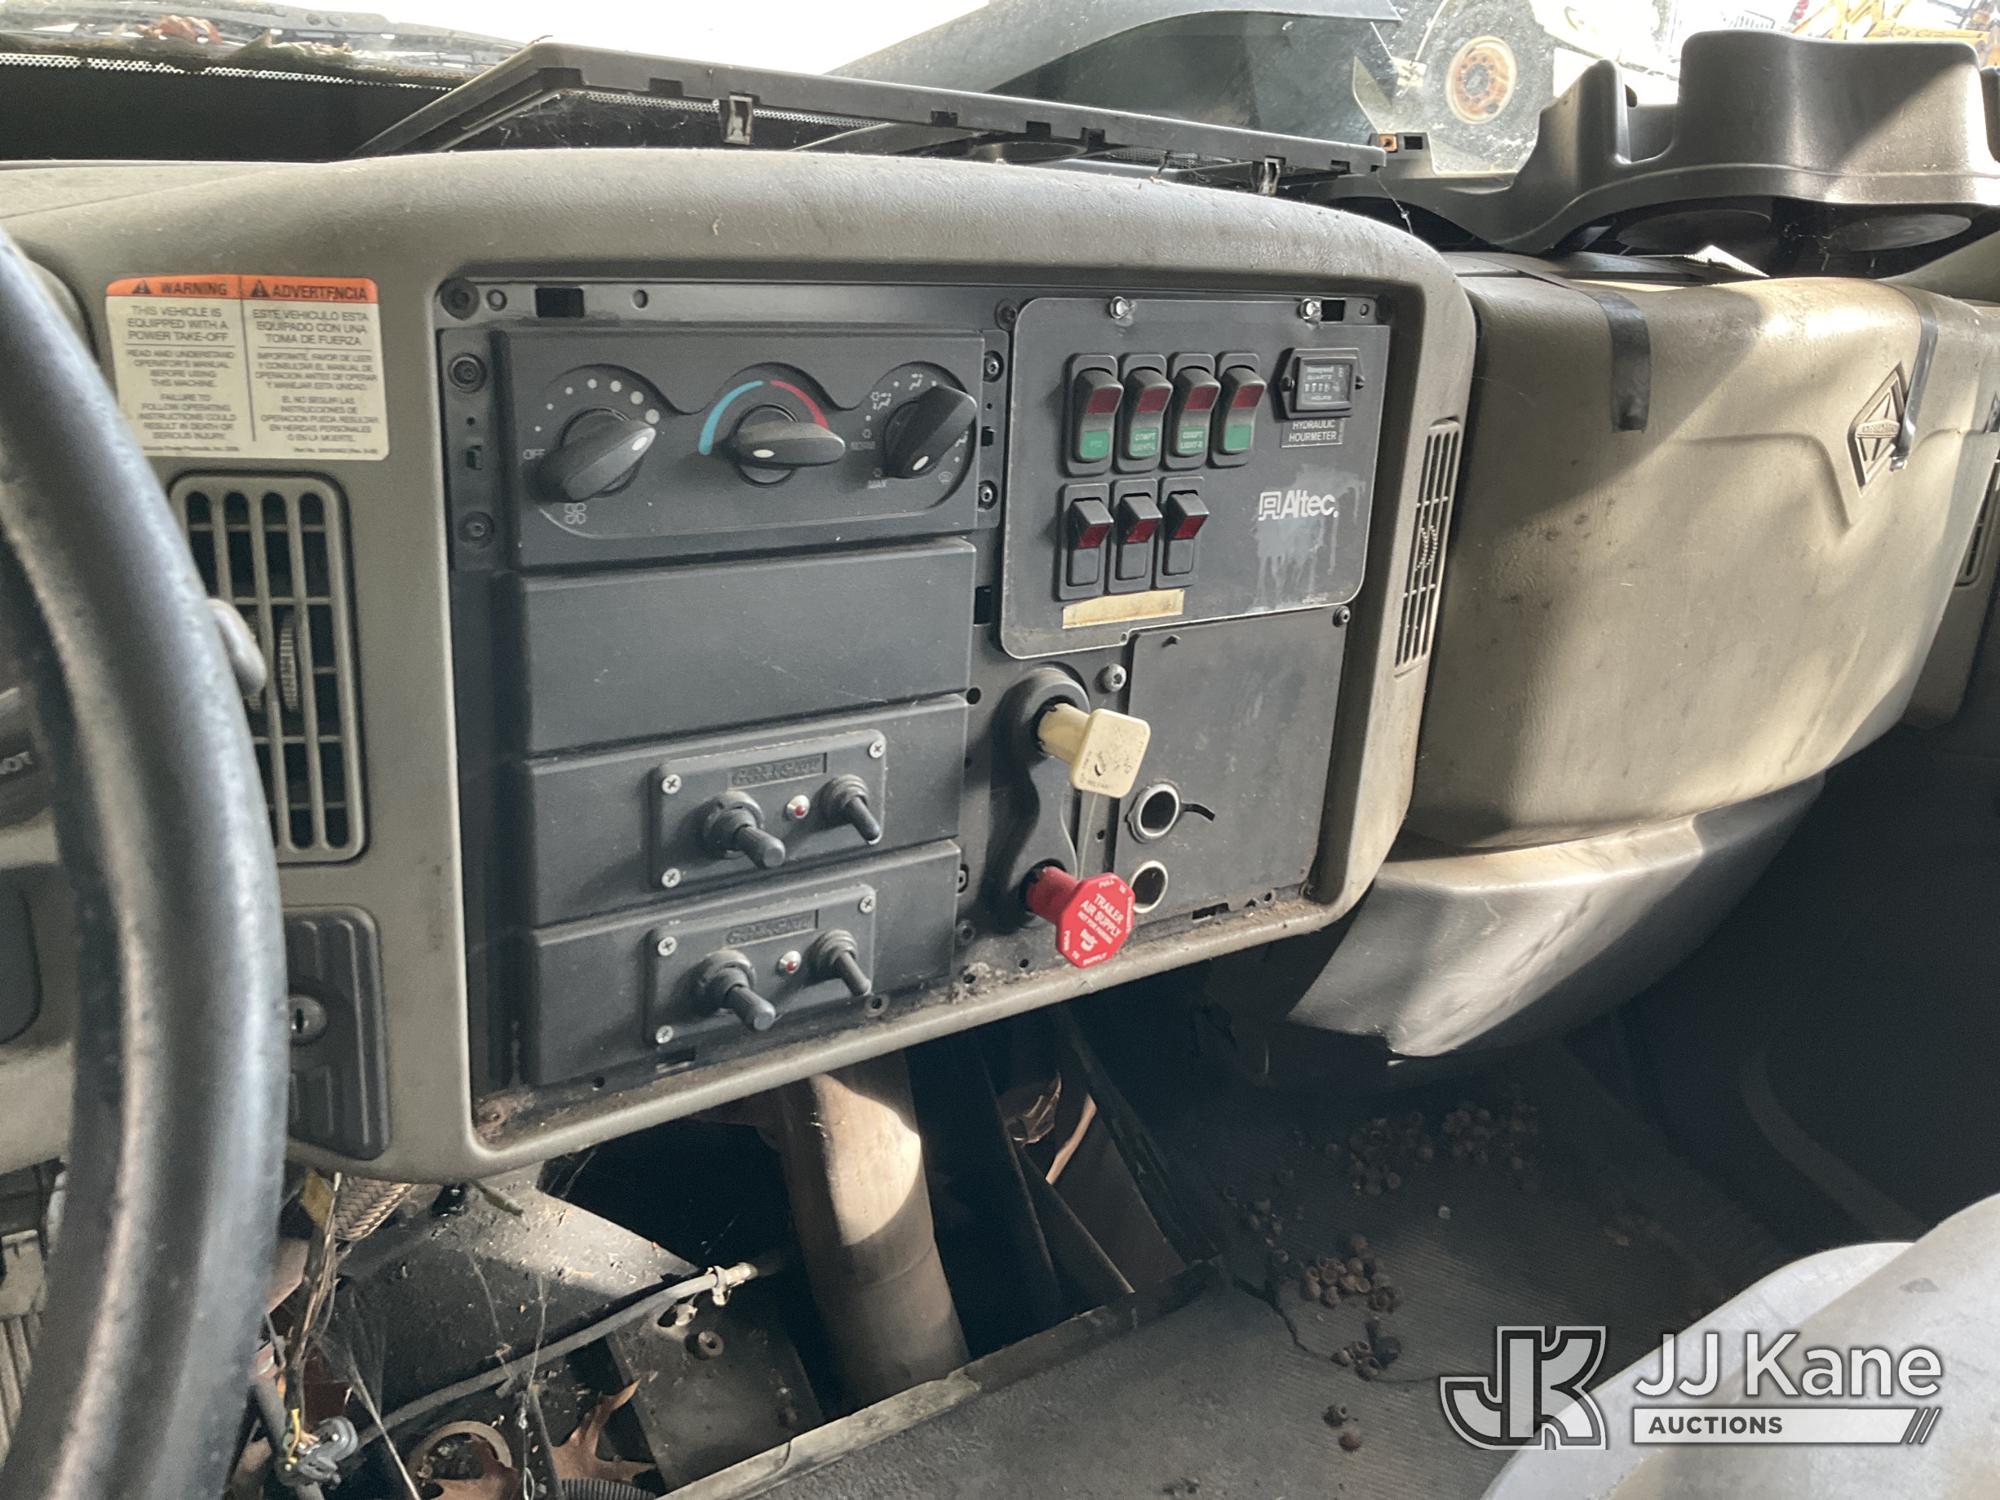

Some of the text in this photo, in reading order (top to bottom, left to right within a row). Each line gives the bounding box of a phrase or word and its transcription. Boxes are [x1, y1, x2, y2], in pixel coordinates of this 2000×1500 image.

[160, 282, 228, 296] WARNING
[130, 305, 222, 318] THIS VEHICLE IS
[252, 309, 281, 319] ESTE
[342, 312, 369, 322] ESTA
[127, 317, 229, 330] EQUIPPED WITH A
[256, 321, 368, 335] EQUIPADO CON UNA
[127, 330, 230, 342] POWER TAKE-OFF
[264, 333, 363, 346] TOMA DE FUERZA
[1291, 419, 1336, 430] HYDRAULIC
[1288, 430, 1338, 443] HOURMETER
[522, 448, 546, 460] OFF
[1094, 893, 1125, 925] TRAILER
[1080, 899, 1122, 938] AIR SUPPLY
